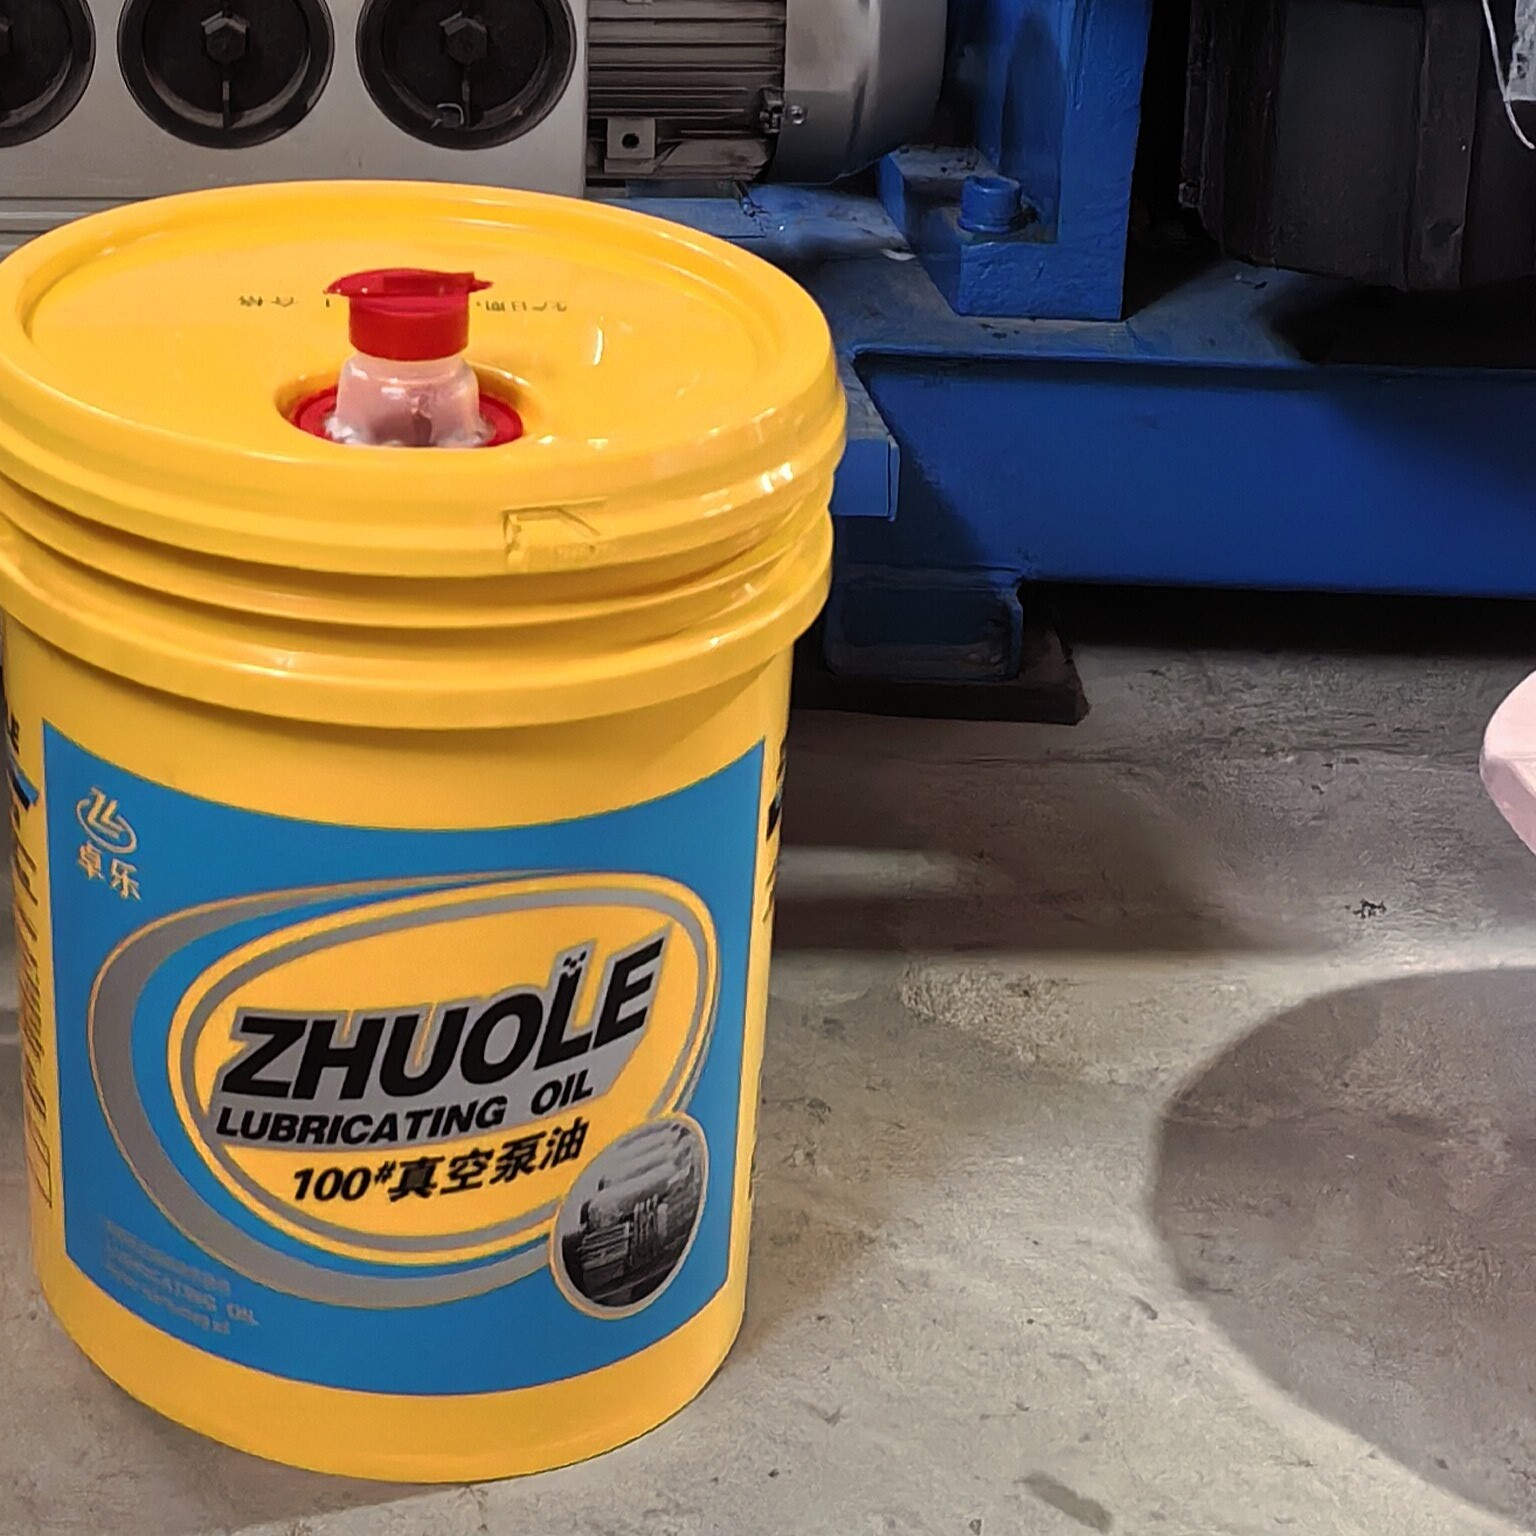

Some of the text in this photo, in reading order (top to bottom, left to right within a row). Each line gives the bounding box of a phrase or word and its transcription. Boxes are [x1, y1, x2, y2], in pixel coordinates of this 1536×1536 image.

[221, 938, 665, 1101] ZHUOLE
[216, 1069, 594, 1145] LUBRICATING OIL
